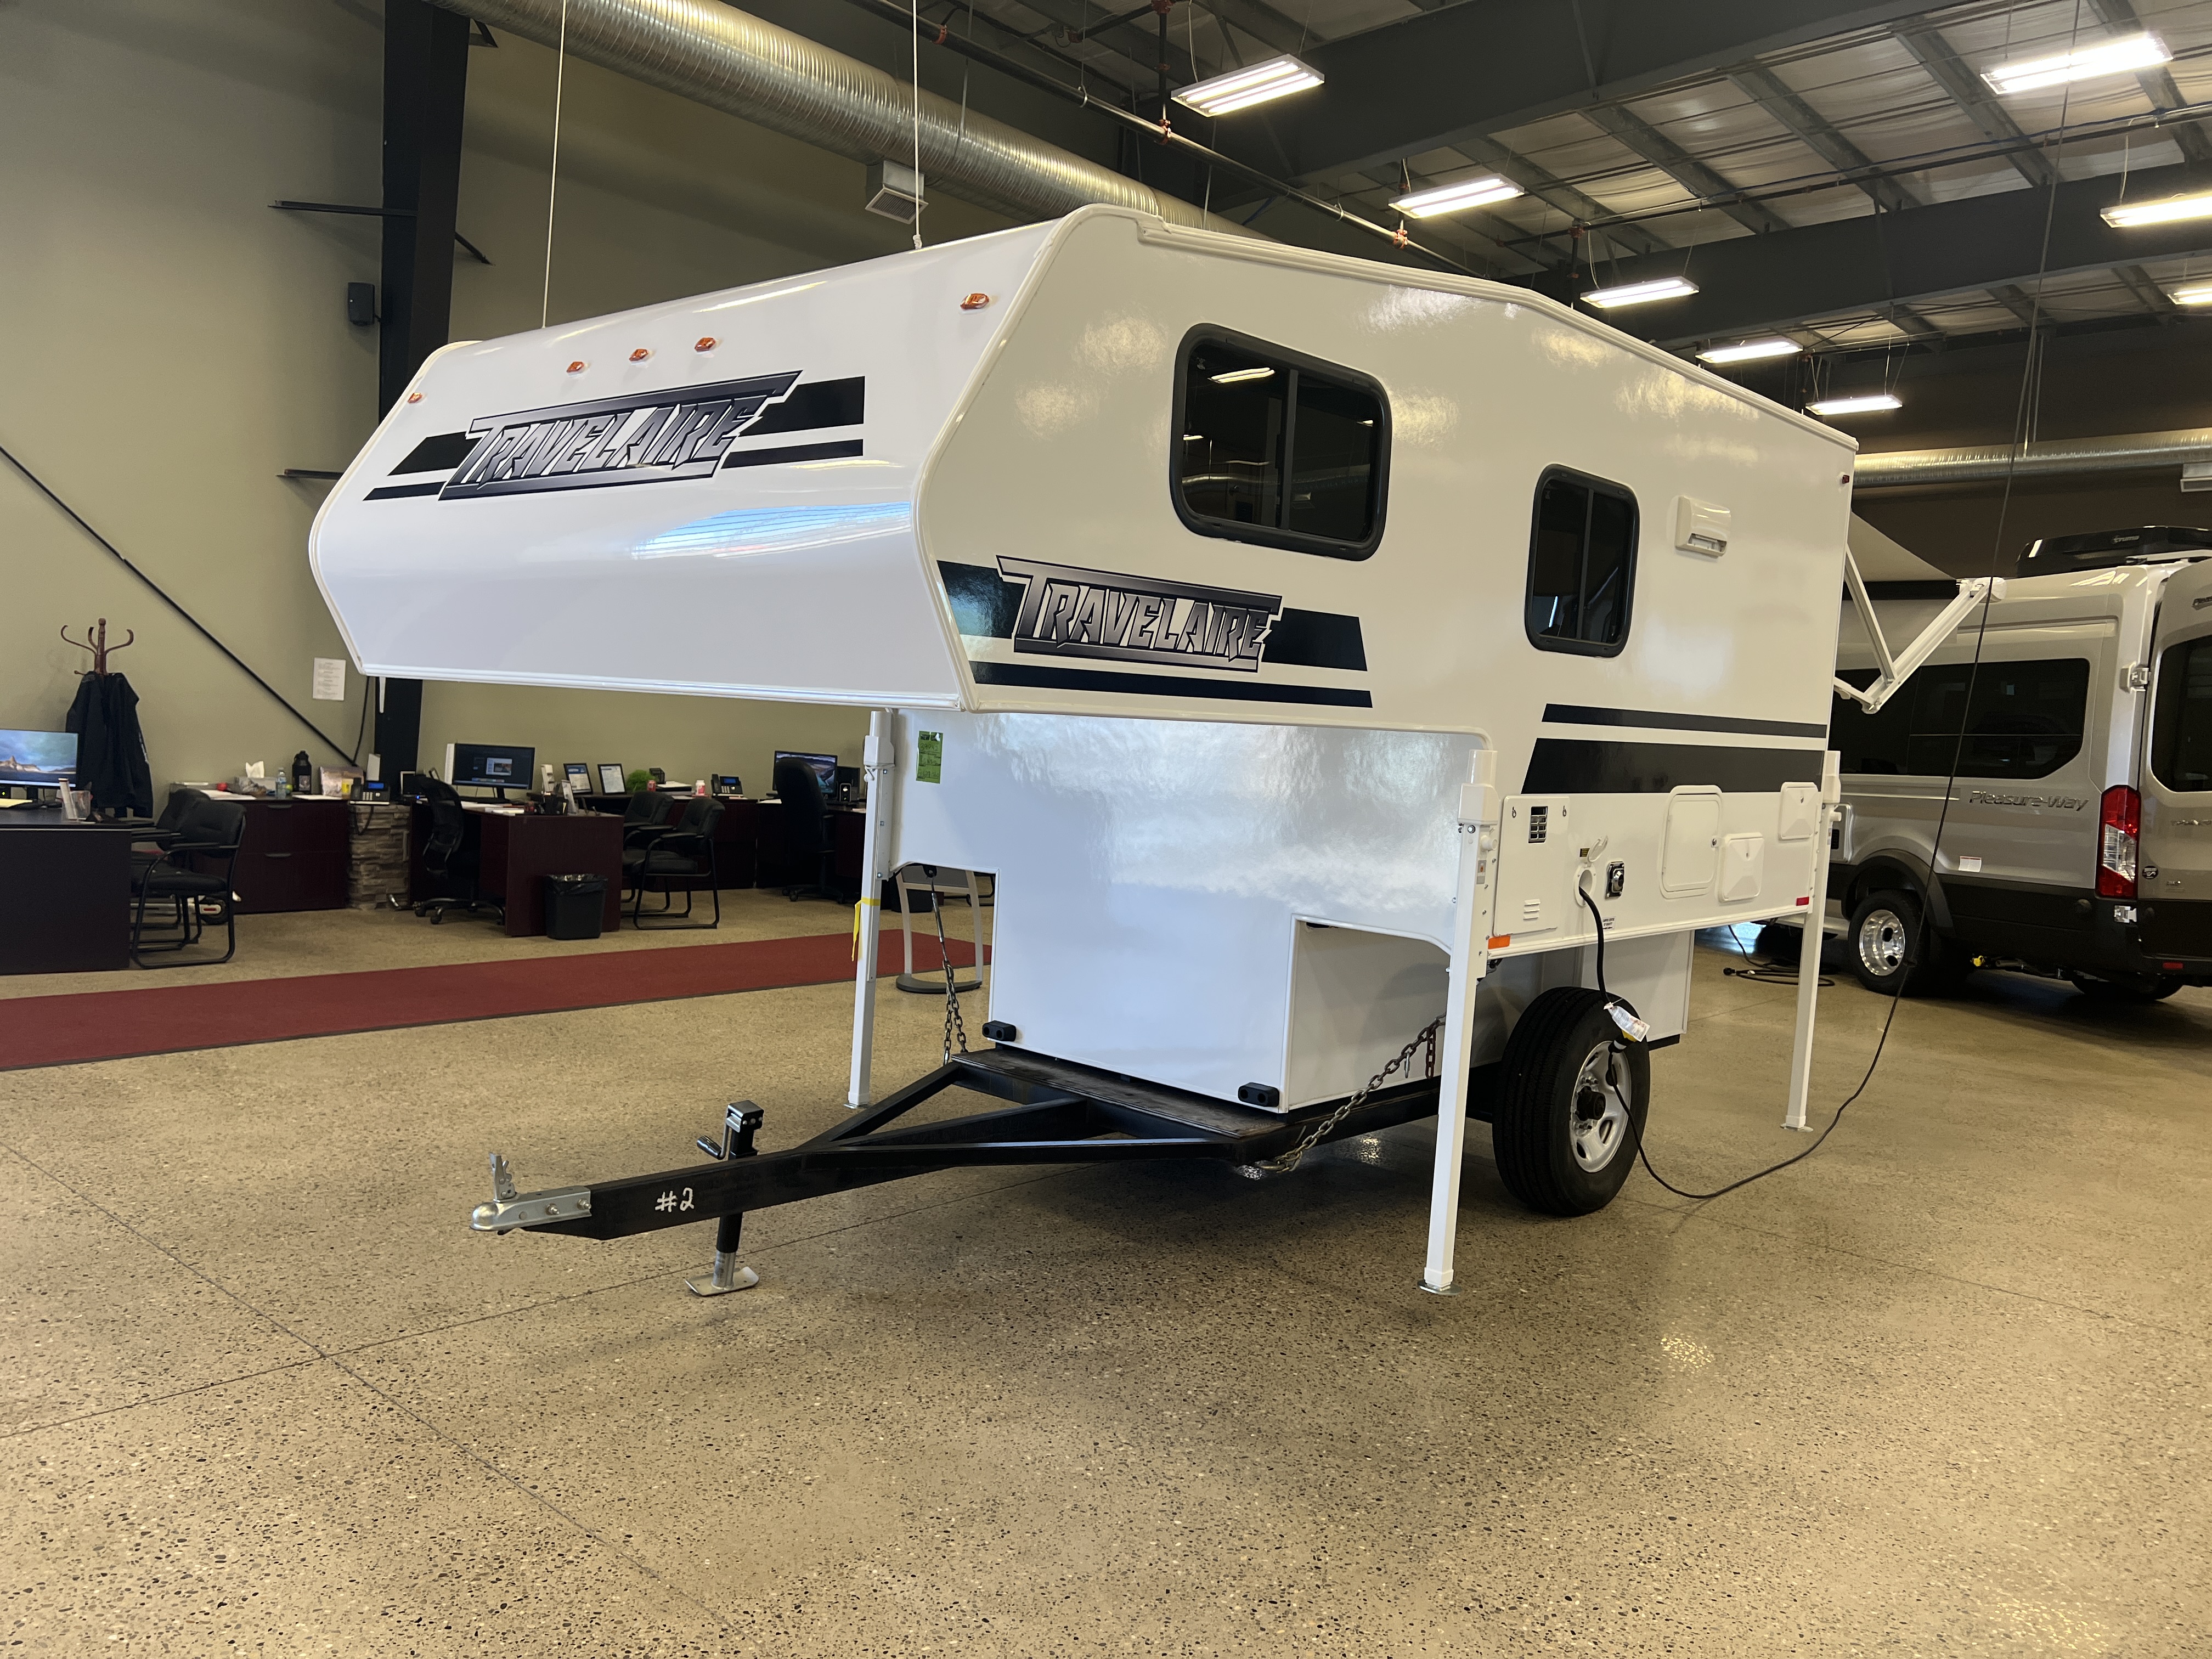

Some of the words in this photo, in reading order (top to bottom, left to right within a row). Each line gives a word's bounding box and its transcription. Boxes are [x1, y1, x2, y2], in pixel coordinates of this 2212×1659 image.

[442, 370, 803, 494] TRAVELAIRE
[996, 555, 1283, 666] TRAVELAIRE
[1969, 791, 2090, 811] Pleasure-Way
[654, 1187, 695, 1212] #2
